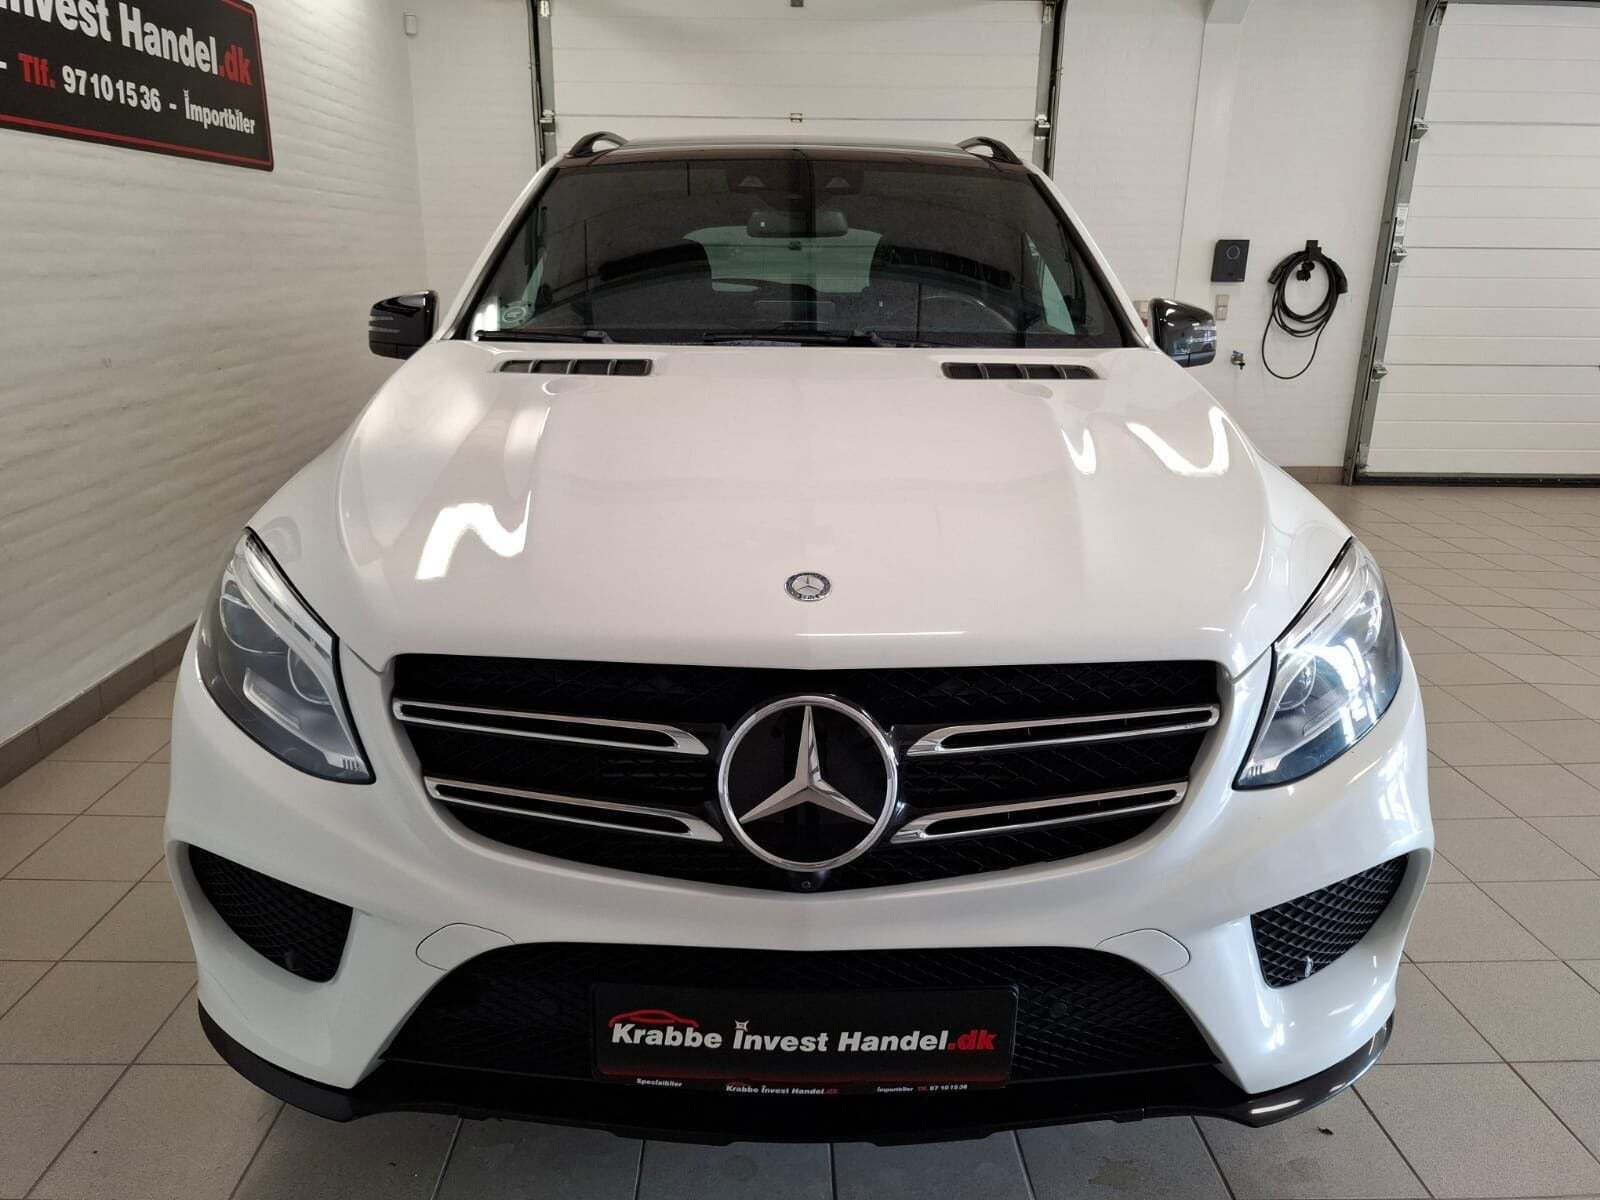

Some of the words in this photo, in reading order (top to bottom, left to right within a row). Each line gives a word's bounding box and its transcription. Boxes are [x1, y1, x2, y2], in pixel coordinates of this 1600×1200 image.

[0, 0, 112, 42] vest
[119, 3, 252, 86] Handel.dk
[17, 52, 56, 88] Tlf.
[183, 89, 256, 135] Importbiler
[611, 1023, 722, 1049] Krabbe
[733, 1020, 828, 1052] Invest
[837, 1030, 998, 1052] Handel.dk
